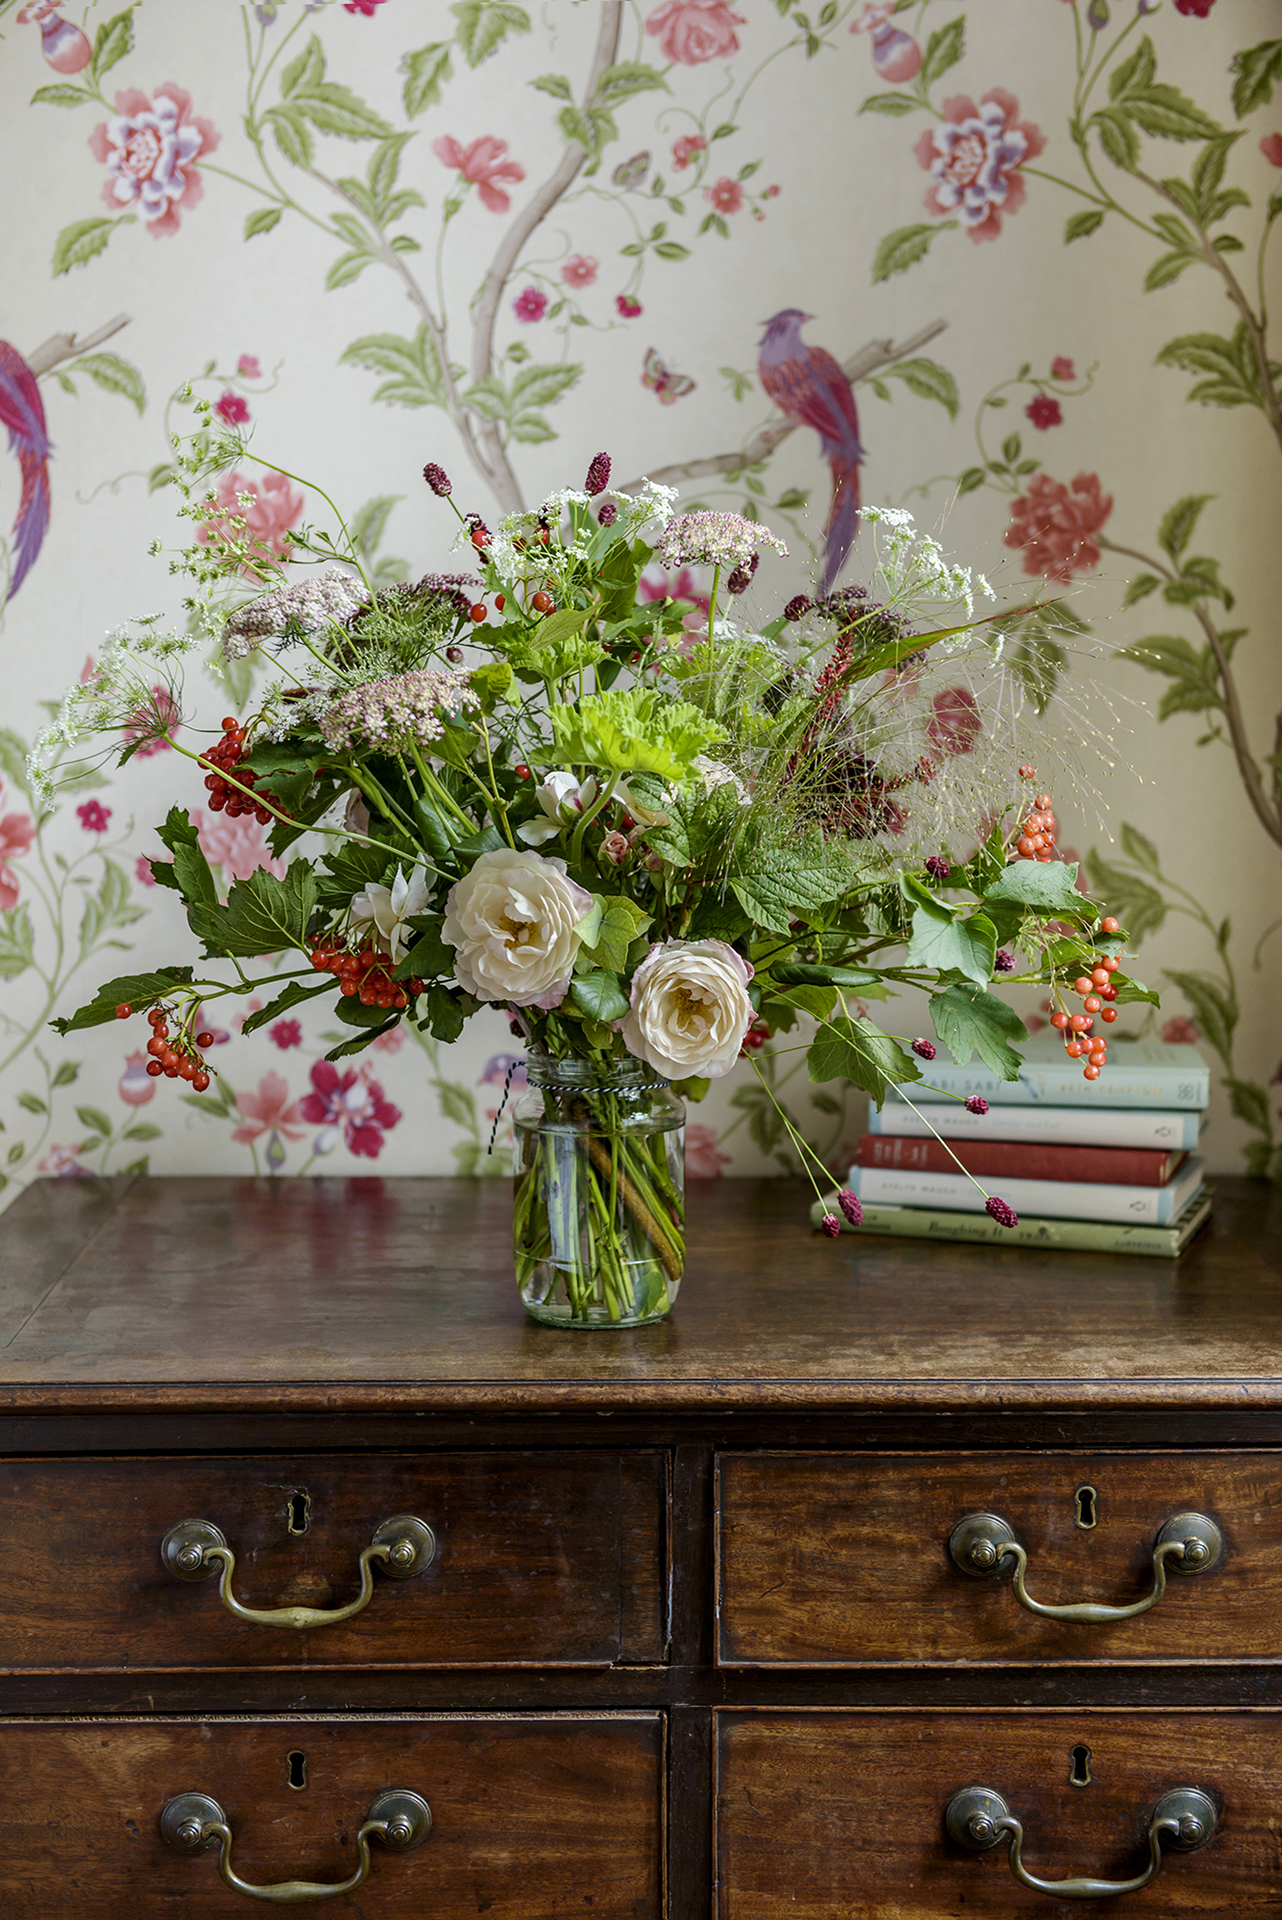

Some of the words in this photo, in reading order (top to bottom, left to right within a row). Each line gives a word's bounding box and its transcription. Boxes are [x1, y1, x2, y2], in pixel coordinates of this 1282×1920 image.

[964, 1079, 1000, 1092] SABI
[1060, 1083, 1092, 1094] BETH
[1099, 1083, 1162, 1096] KEMPTON
[928, 1221, 987, 1239] Roughing
